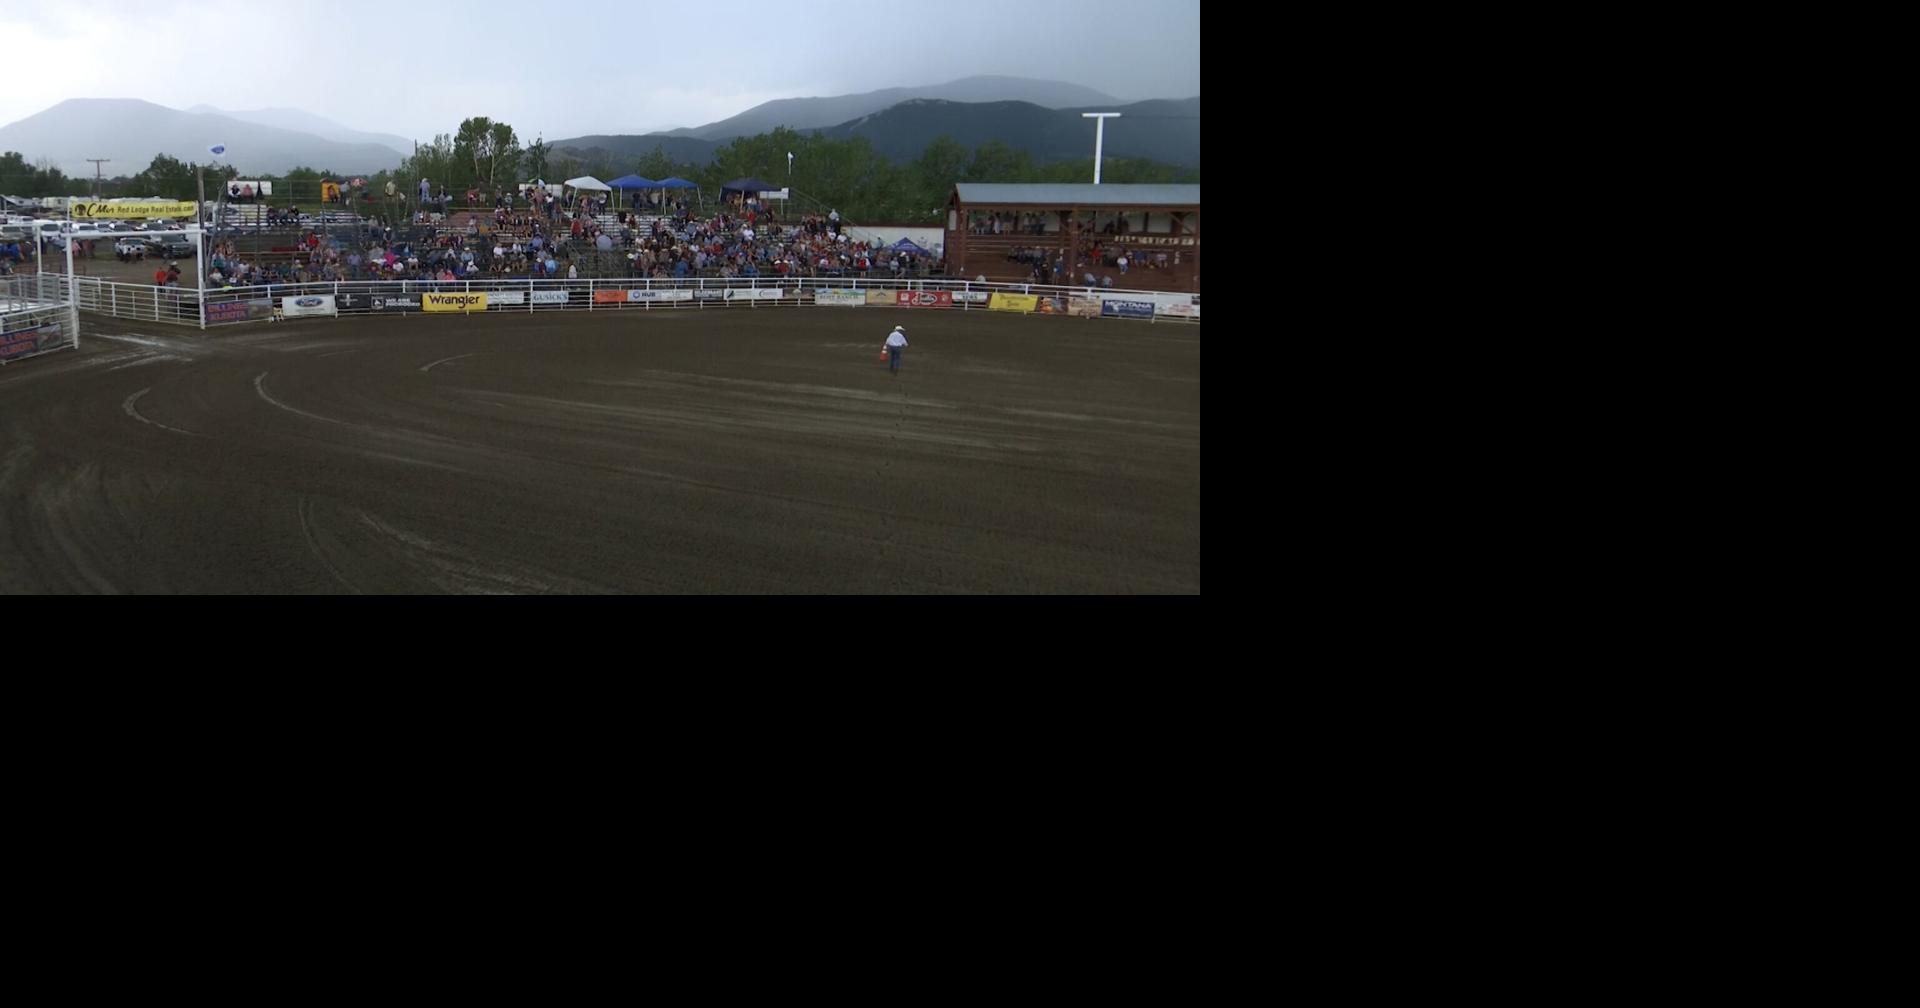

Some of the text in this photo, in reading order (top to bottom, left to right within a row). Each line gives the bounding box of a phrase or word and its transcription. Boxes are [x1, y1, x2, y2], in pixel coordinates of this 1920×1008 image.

[131, 206, 149, 214] Lodge
[429, 295, 480, 309] Wrangler
[1104, 301, 1152, 309] MONTANA
